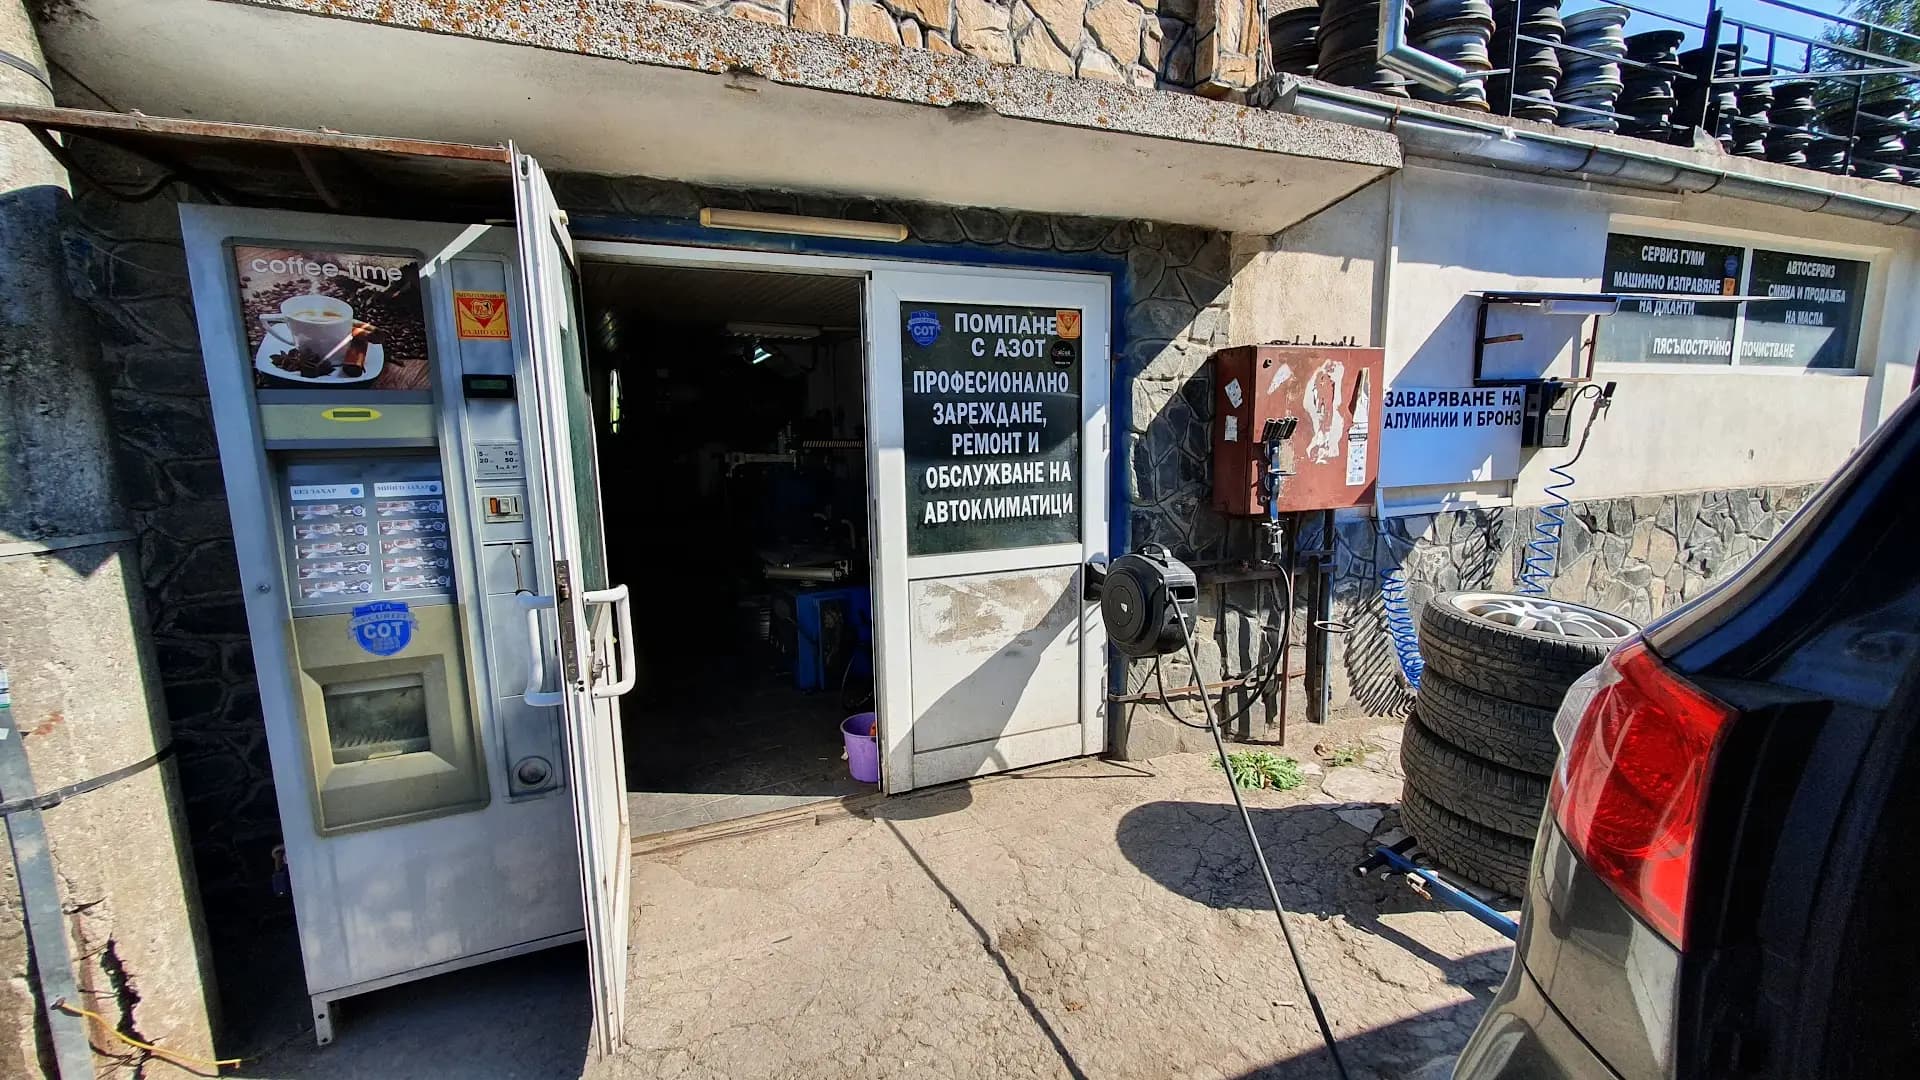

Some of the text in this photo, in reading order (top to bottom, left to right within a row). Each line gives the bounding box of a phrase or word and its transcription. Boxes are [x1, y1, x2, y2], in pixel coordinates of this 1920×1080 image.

[1641, 245, 1706, 266] СЕРВИЗ ГУМИ
[252, 257, 403, 281] coffee time
[1786, 261, 1836, 279] АВТОСЕРВИЗ
[1613, 271, 1721, 294] МАШИННО ИЗПРАВЯНЕ
[1768, 284, 1846, 303] СМЯНА И ПРОДАЖБА
[1639, 299, 1696, 317] НА ДЖАНТИ
[1784, 310, 1824, 326] НА МАСЛА
[954, 312, 1057, 336] ПОМПАНЕ
[971, 338, 984, 357] С
[994, 338, 1046, 358] АЗОТ
[1653, 337, 1796, 358] ПЯСЪКОСТРУЙНО ПОЧИСТВАНЕ
[913, 371, 1069, 393] ПРОФЕСИОНАЛНО
[1384, 391, 1521, 408] ЗАВАРЯВАНЕ НА
[932, 402, 1047, 428] ЗАРЕЖДАНЕ,
[1463, 411, 1472, 427] И
[1477, 410, 1521, 427] БРОНЗ
[952, 432, 1039, 455] РЕМОНТ И
[925, 461, 1072, 489] ОБСЛУЖВАНЕ НА
[924, 492, 1073, 524] АВТОКЛИМАТИЦИ
